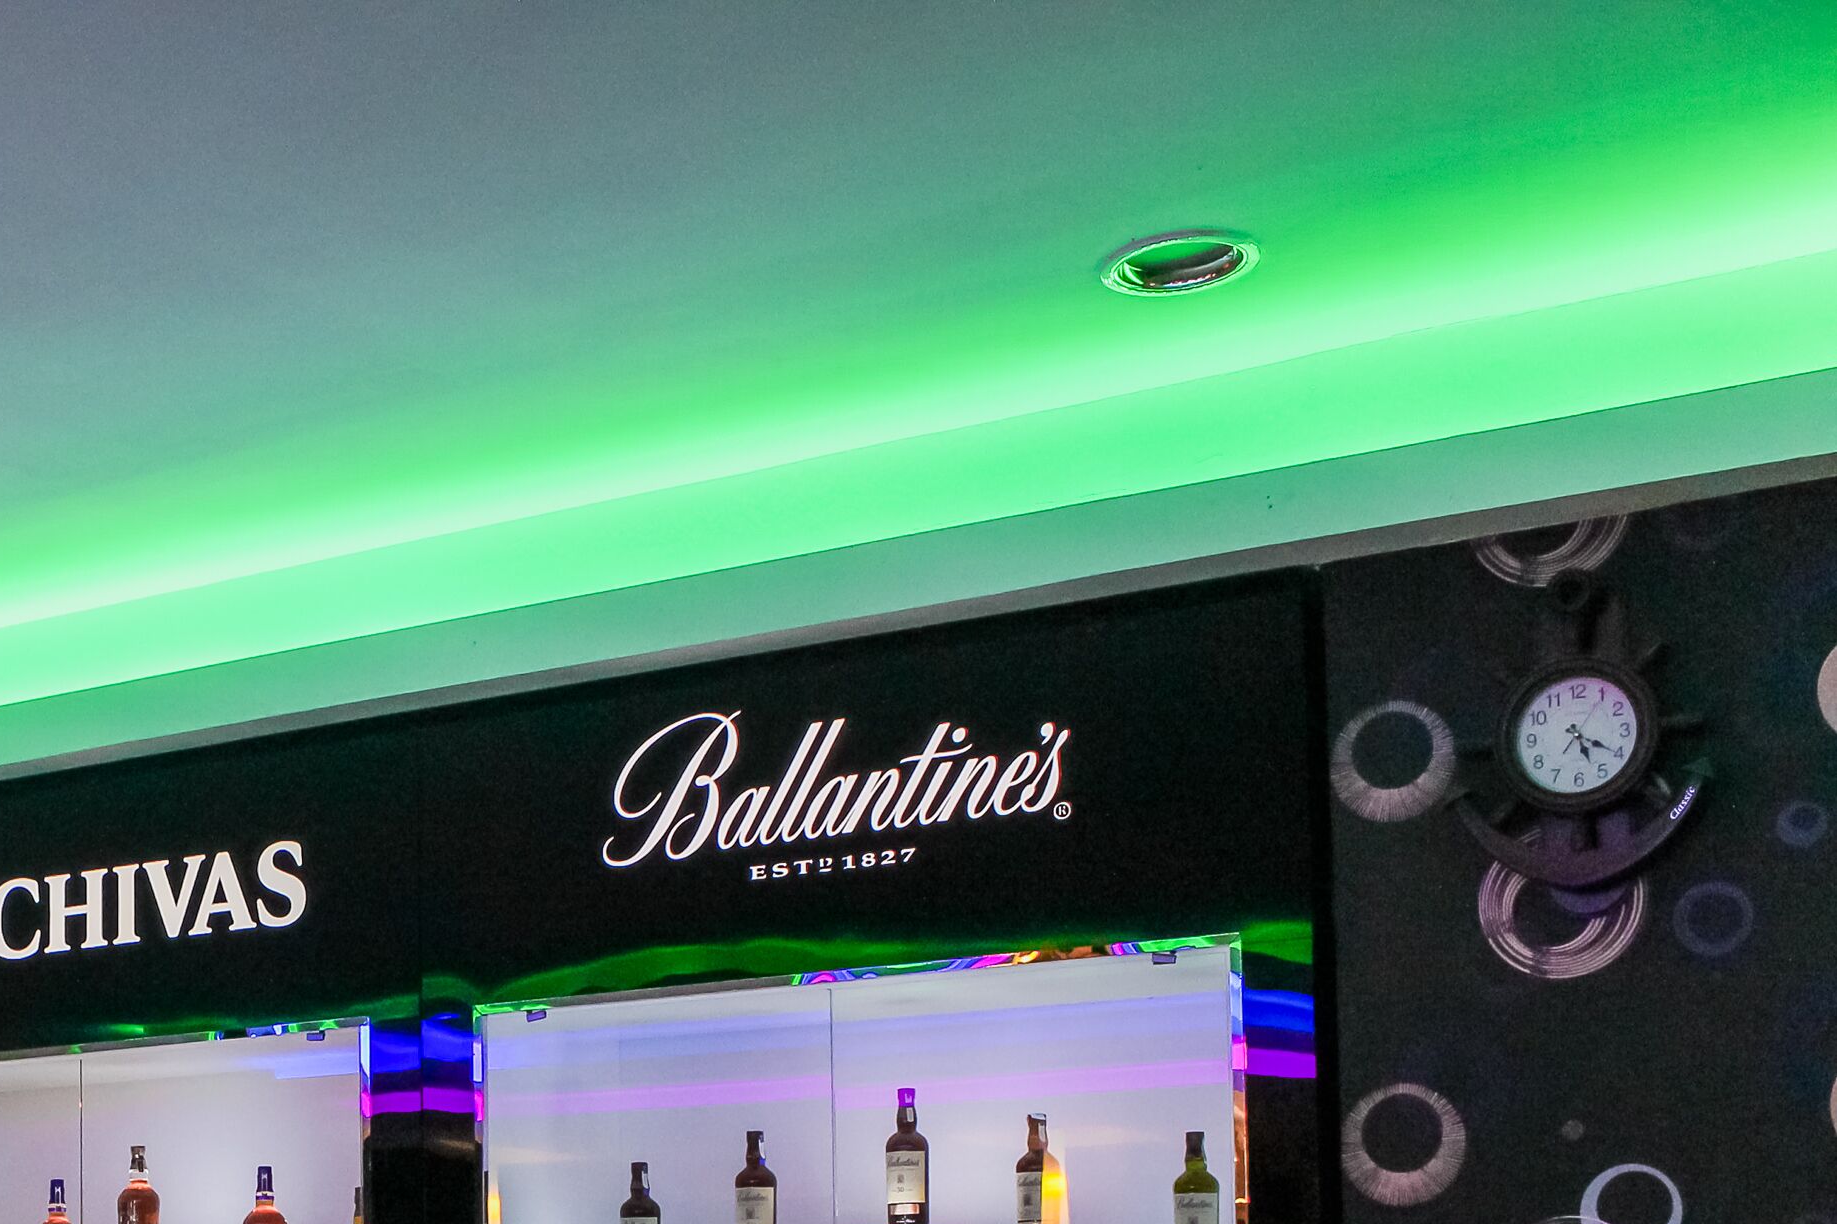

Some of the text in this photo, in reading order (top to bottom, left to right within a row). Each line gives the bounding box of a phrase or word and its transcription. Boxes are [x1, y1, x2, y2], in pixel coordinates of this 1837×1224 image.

[1569, 684, 1587, 699] 12
[1598, 687, 1605, 702] 1
[1546, 693, 1561, 708] 11
[1613, 701, 1624, 716] 2
[1530, 710, 1547, 726] 10
[1619, 722, 1631, 738] 3
[1526, 733, 1537, 748] 9
[1613, 746, 1624, 760] 4
[1533, 755, 1544, 770] 8
[1551, 768, 1561, 783] 7
[1597, 763, 1608, 779] 5
[1574, 772, 1585, 787] 6
[602, 709, 1069, 868] Ballantine's
[1669, 785, 1697, 820] Classic
[841, 848, 916, 871] 1827
